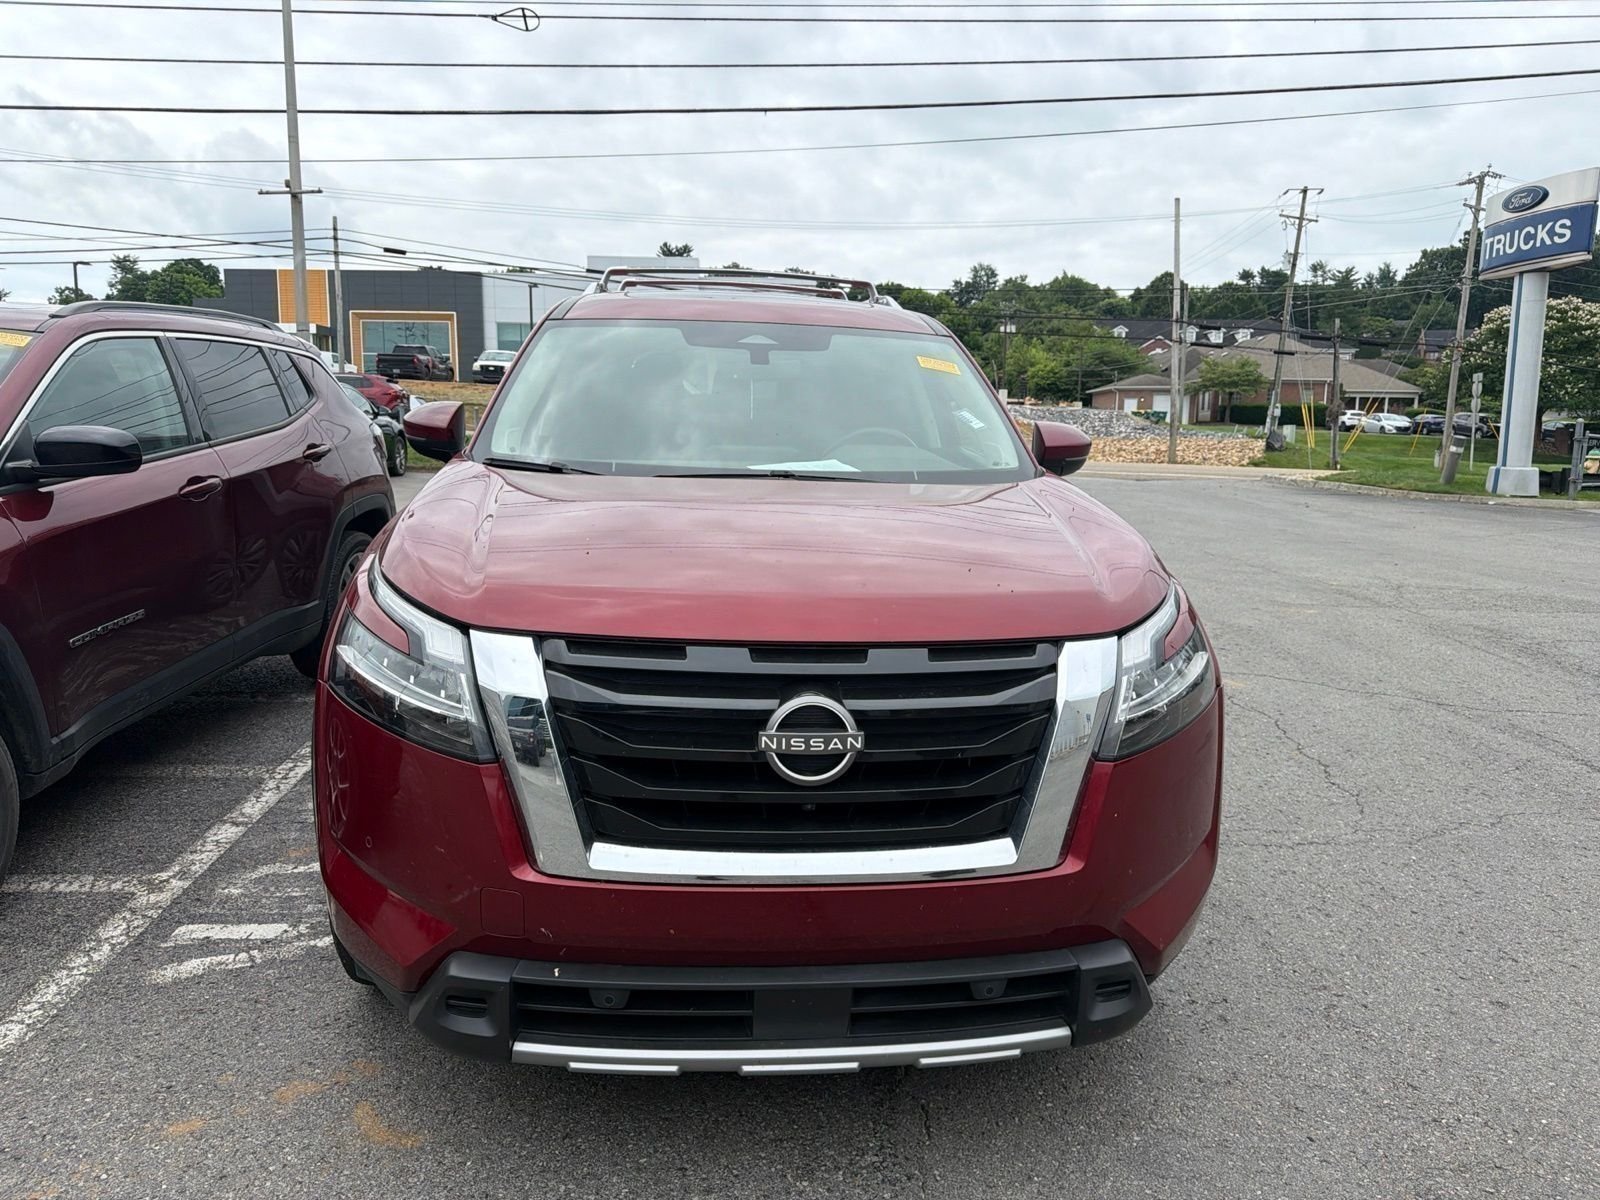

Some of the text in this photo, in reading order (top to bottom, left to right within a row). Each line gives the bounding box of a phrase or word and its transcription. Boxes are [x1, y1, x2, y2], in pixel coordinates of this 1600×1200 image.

[1509, 192, 1533, 209] Ford
[1484, 218, 1572, 260] TRUCKS
[761, 736, 862, 751] NISSAN
